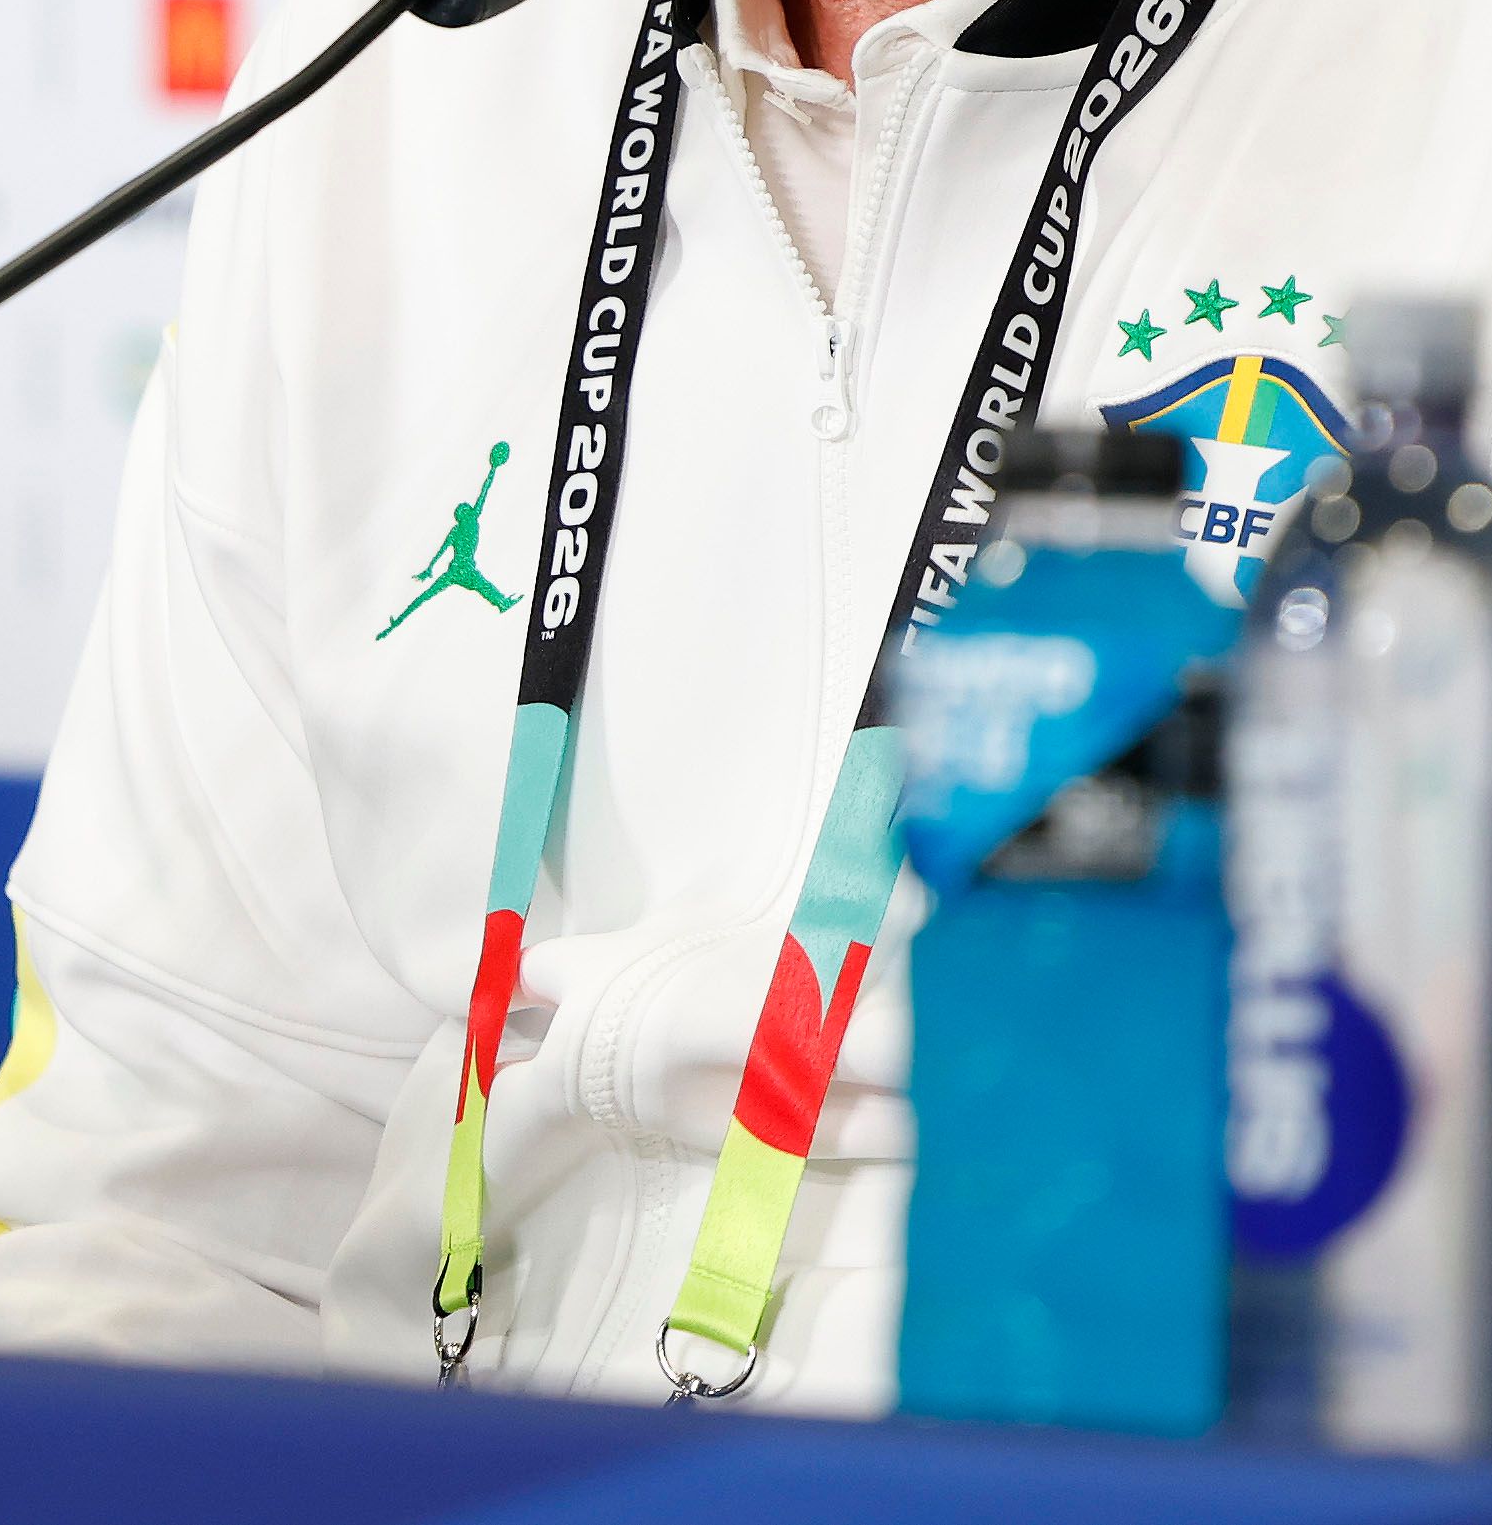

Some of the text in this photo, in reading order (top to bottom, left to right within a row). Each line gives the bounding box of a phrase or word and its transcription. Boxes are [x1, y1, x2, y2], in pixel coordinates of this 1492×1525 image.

[601, 73, 666, 285] WORLD
[580, 296, 625, 413] CUP
[942, 313, 1040, 525] WORLD
[1023, 185, 1072, 307] CUP
[543, 425, 606, 630] 2026
[1173, 499, 1275, 548] CBF
